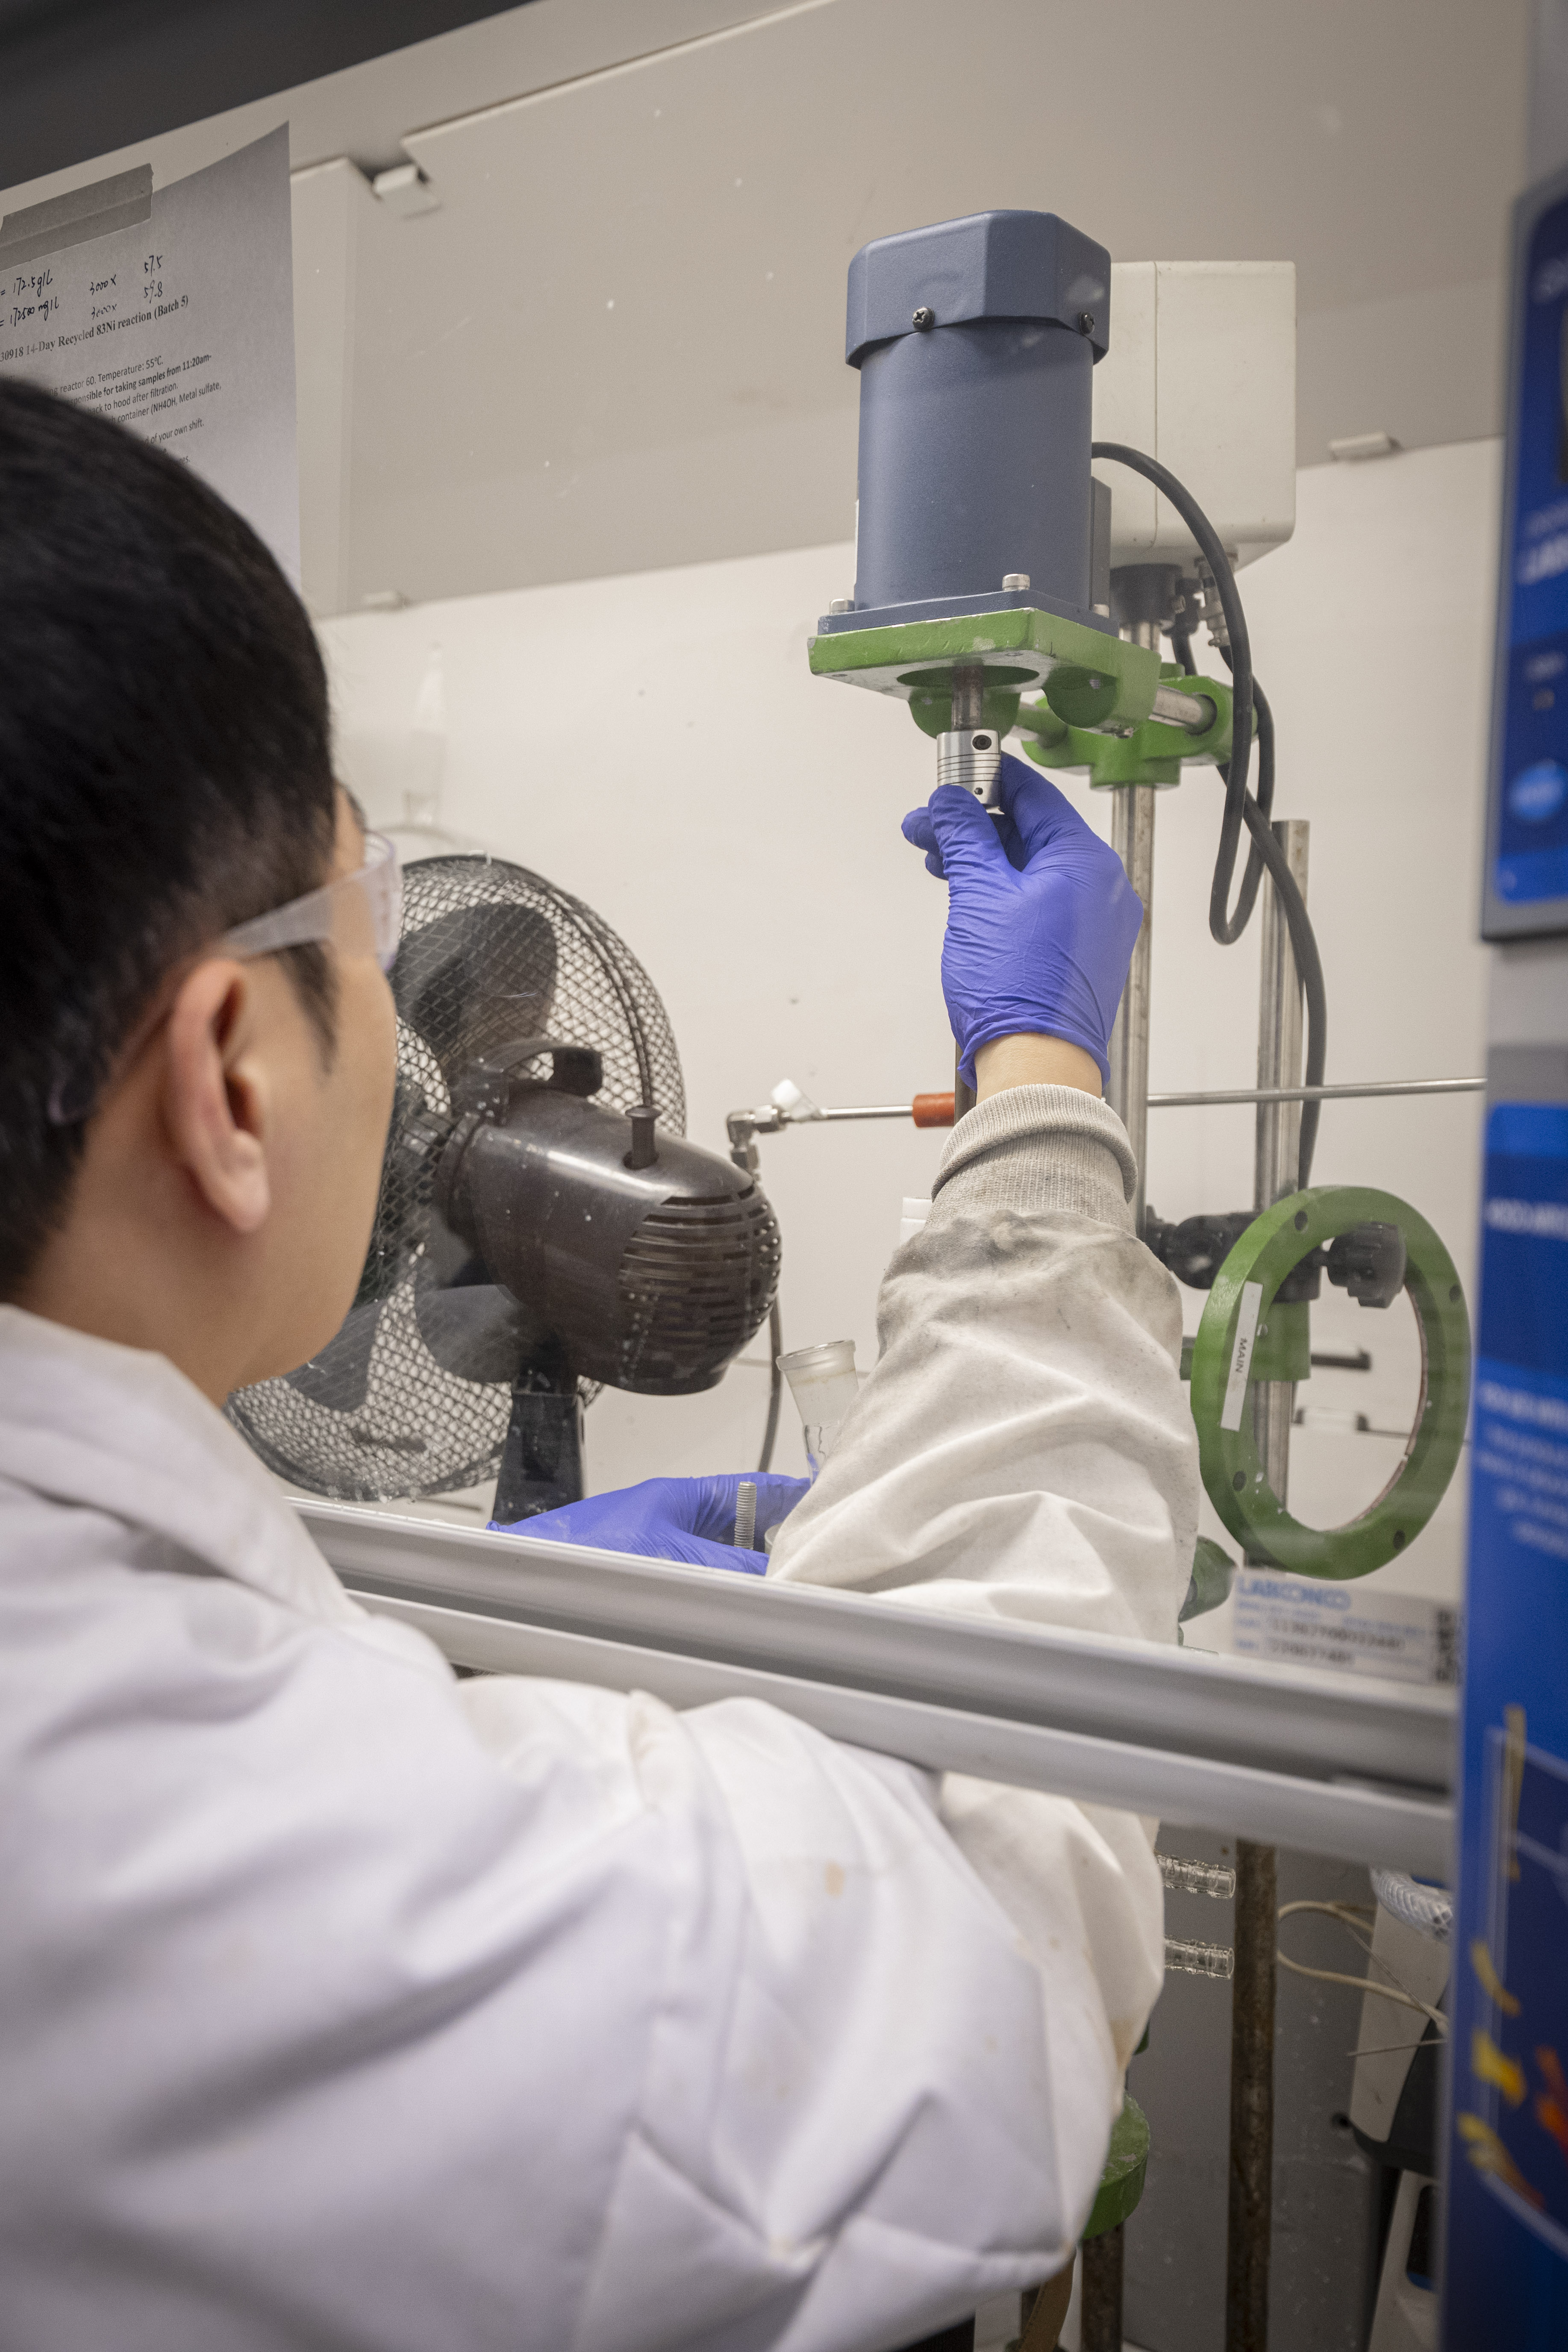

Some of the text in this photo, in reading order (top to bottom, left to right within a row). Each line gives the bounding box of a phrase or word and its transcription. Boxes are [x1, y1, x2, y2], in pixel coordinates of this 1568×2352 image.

[144, 255, 163, 276] 57.5
[144, 279, 163, 304] 59.8
[26, 341, 56, 355] 14-Day
[58, 327, 94, 347] Recycled
[97, 320, 115, 336] 83Ni
[118, 312, 152, 329] reaction
[154, 299, 179, 320] (Batch
[181, 295, 188, 309] 5)
[60, 381, 85, 393] reactor
[86, 376, 96, 386] 60.
[98, 363, 144, 382] Temperature:
[146, 356, 163, 369] 55°C.
[104, 387, 114, 396] for
[115, 381, 136, 393] taking
[138, 372, 166, 387] samples
[167, 365, 181, 377] from
[182, 354, 212, 371] 11:20am-
[104, 403, 112, 411] to
[113, 396, 130, 409] hood
[132, 391, 149, 404] after
[150, 382, 178, 399] filtration.
[118, 407, 149, 423] container
[151, 396, 178, 415] (NH4OH,
[179, 391, 197, 403] Metal
[199, 382, 221, 397] sulfate,
[151, 433, 158, 444] of
[159, 430, 173, 444] your
[174, 424, 188, 436] own
[189, 418, 204, 432] shift.
[1235, 1338, 1247, 1373] MAIN
